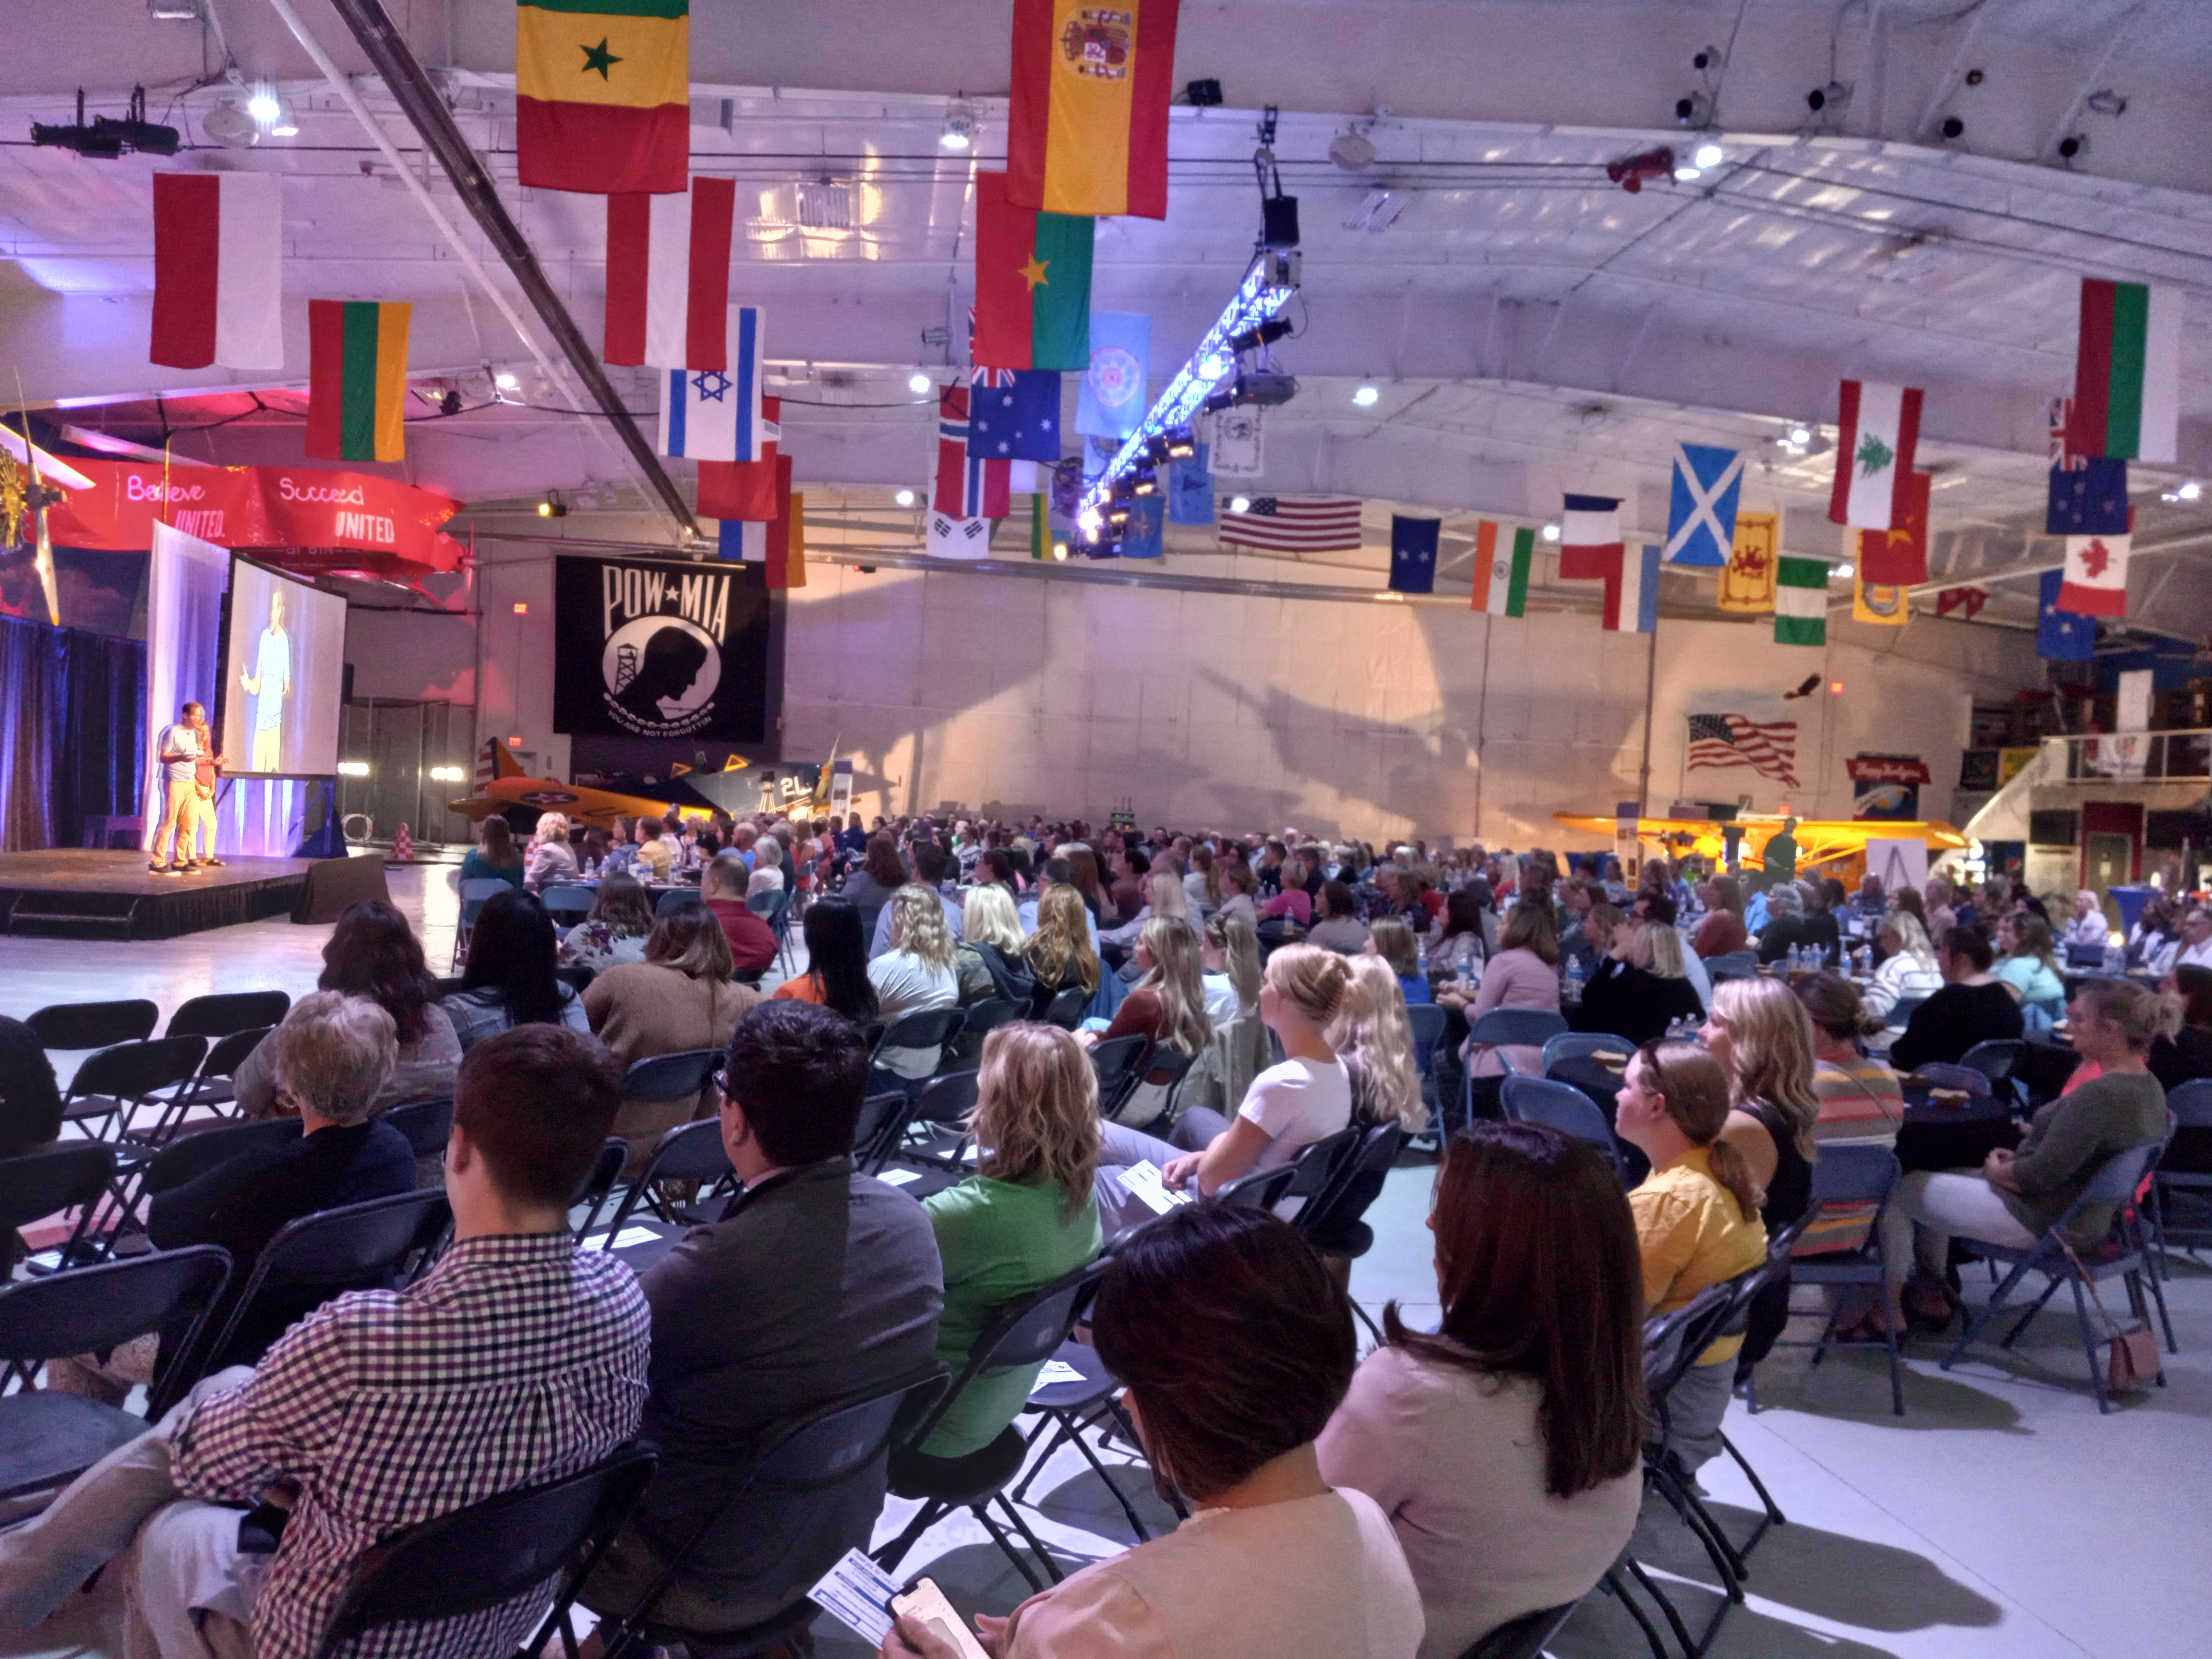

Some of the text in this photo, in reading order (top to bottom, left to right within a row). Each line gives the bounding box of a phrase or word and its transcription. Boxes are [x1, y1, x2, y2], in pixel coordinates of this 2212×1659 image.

[280, 477, 365, 505] Succeed
[602, 565, 731, 648] POW MIA
[642, 729, 661, 737] NOT
